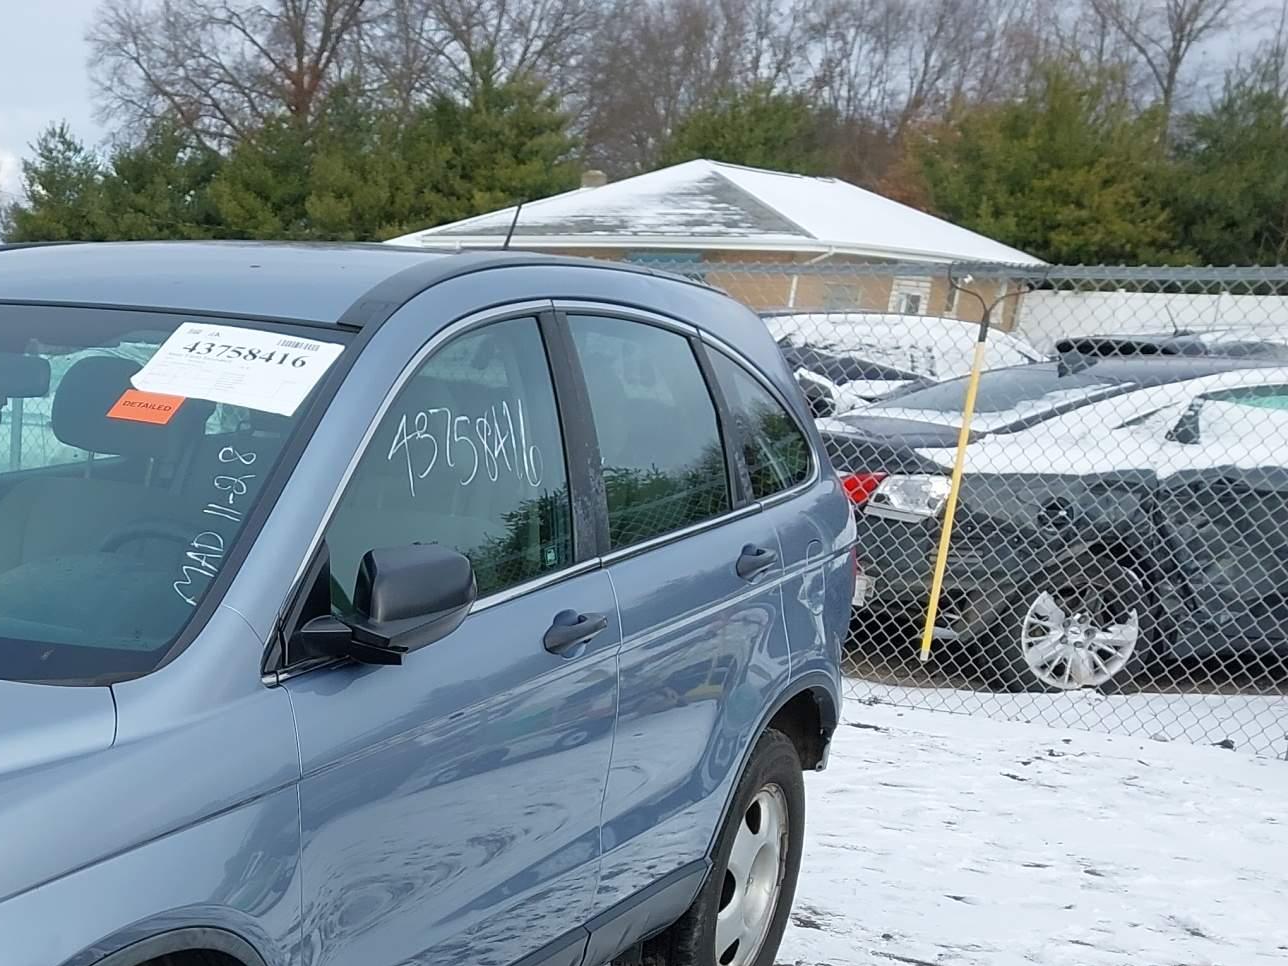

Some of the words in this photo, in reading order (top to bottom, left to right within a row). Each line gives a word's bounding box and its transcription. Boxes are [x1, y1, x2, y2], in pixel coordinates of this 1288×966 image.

[182, 340, 308, 369] 43758416
[122, 400, 173, 412] DETAILED
[173, 531, 224, 607] MAD
